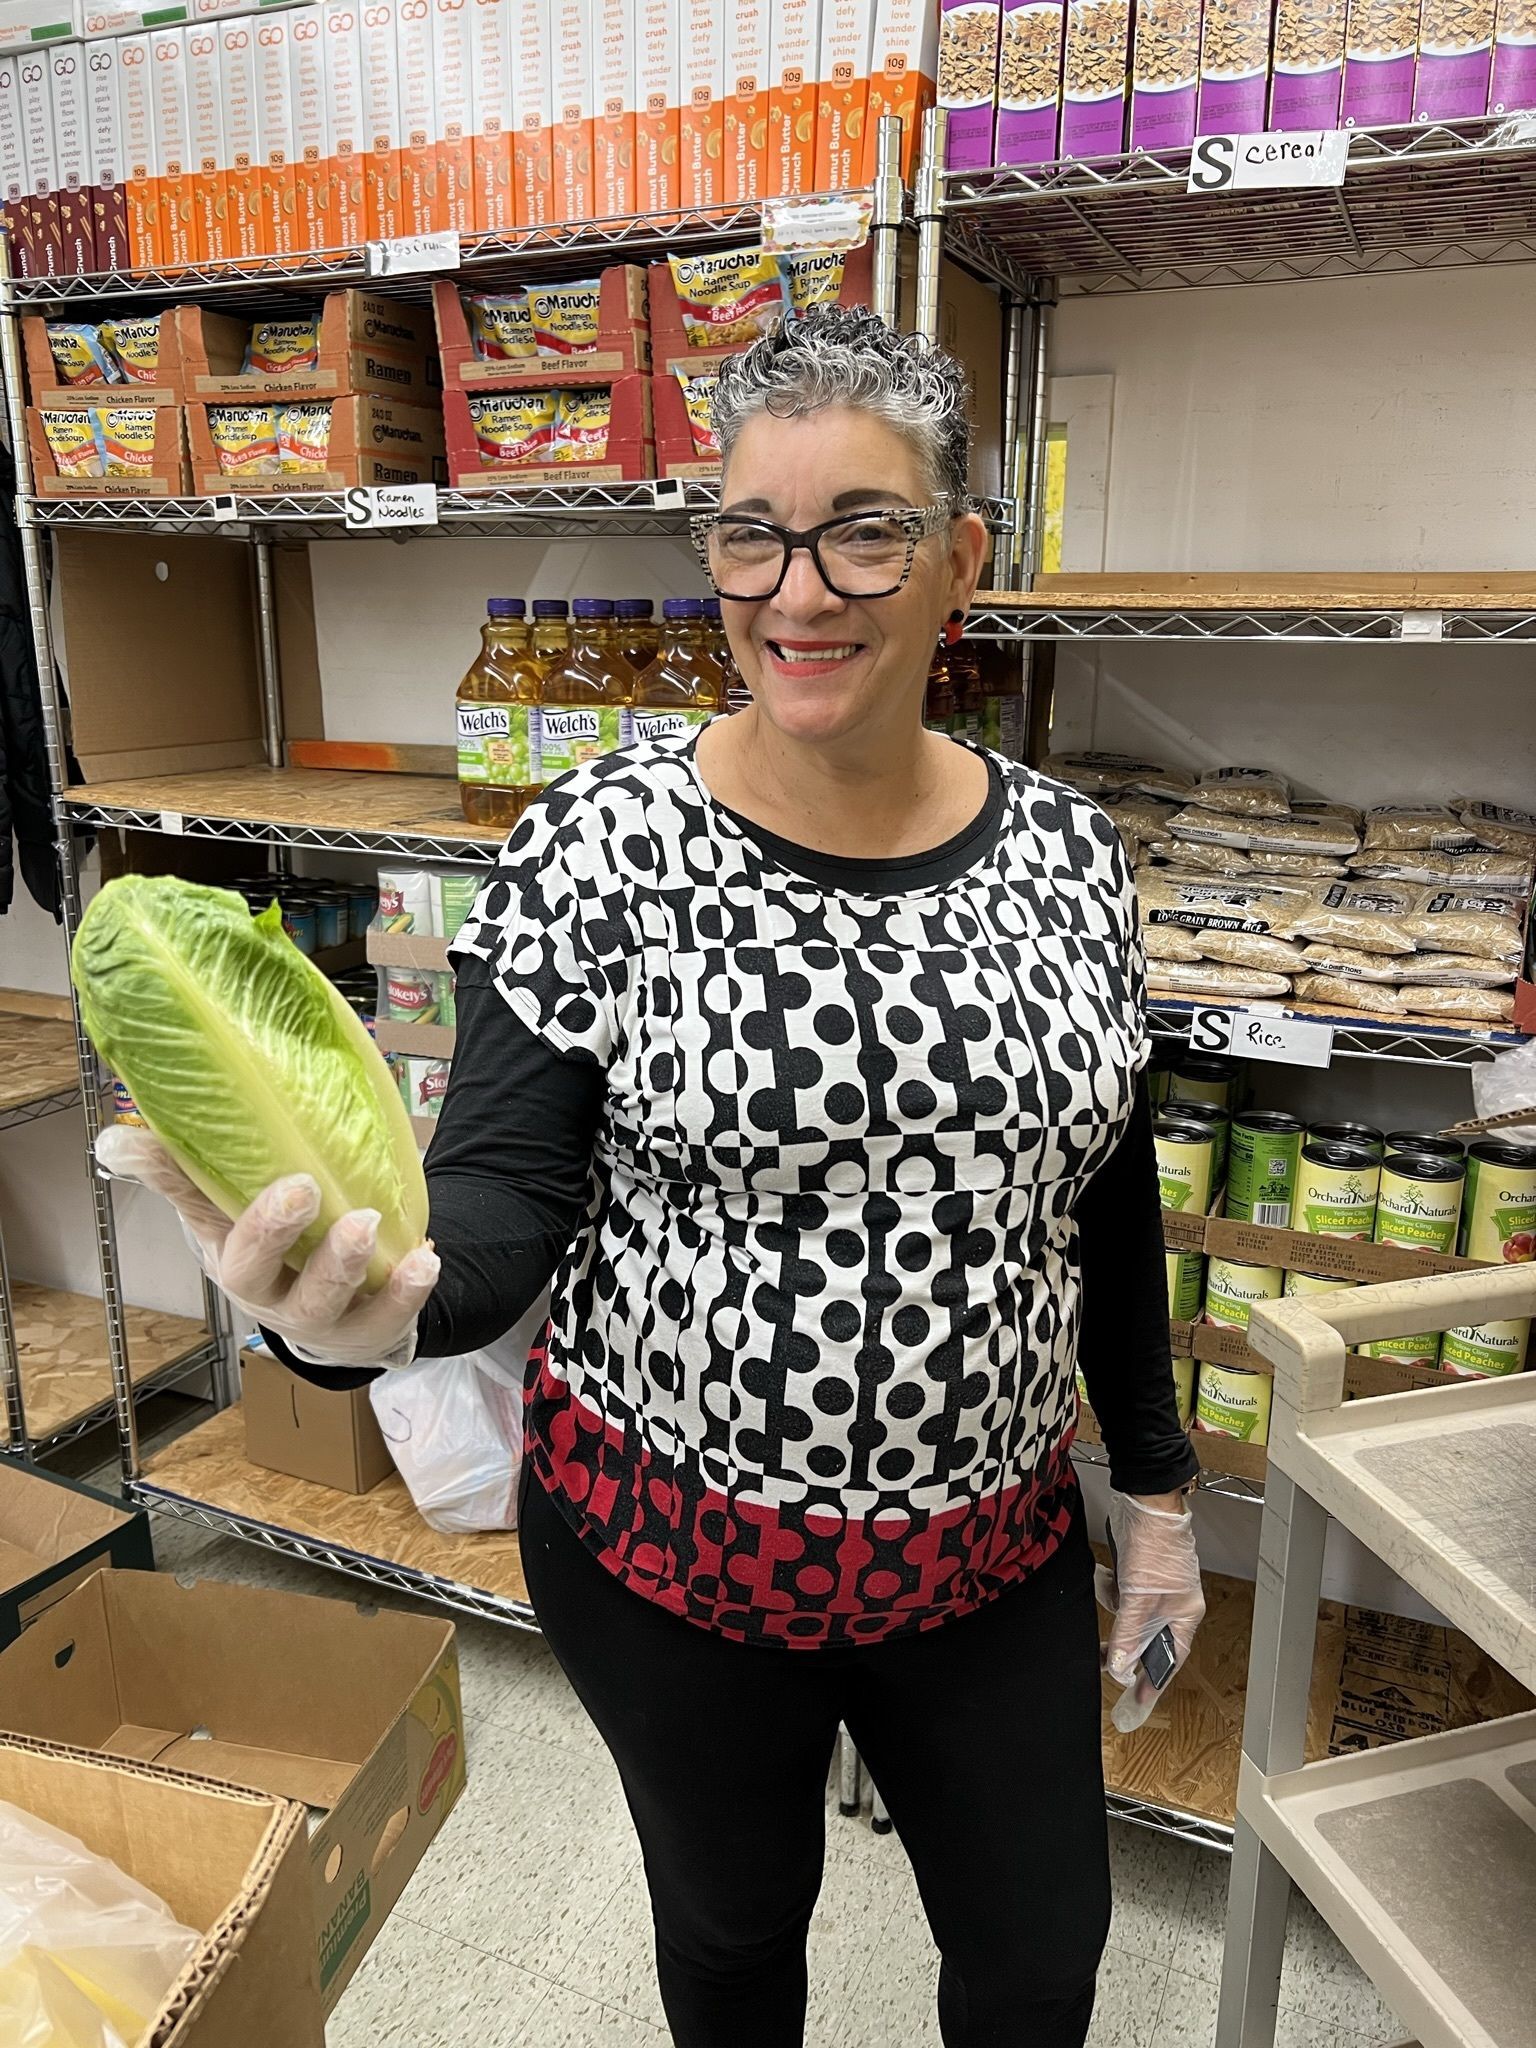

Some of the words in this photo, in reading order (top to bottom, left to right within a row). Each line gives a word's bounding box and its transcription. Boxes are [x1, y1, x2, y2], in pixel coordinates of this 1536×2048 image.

[400, 1, 427, 21] GO
[645, 1, 667, 14] spark
[692, 5, 710, 17] flow
[836, 6, 856, 18] defy
[364, 6, 391, 28] GO
[647, 13, 666, 25] flow
[735, 8, 759, 20] crush
[784, 12, 804, 24] defy
[890, 9, 910, 21] love
[328, 13, 354, 35] GO
[690, 18, 713, 31] crush
[736, 21, 757, 33] defy
[836, 18, 855, 29] love
[882, 22, 917, 34] wander
[258, 26, 284, 46] GO
[293, 20, 319, 42] GO
[645, 26, 668, 39] crush
[784, 25, 804, 36] love
[224, 31, 249, 50] GO
[692, 32, 711, 44] defy
[737, 34, 756, 45] love
[777, 38, 811, 50] wander
[828, 33, 862, 44] wander
[885, 37, 911, 48] shine
[155, 41, 179, 62] GO
[190, 36, 214, 57] GO
[647, 40, 666, 52] defy
[692, 45, 710, 56] love
[832, 46, 856, 57] shine
[122, 47, 145, 66] GO
[730, 46, 764, 59] wander
[781, 50, 805, 62] shine
[89, 53, 112, 72] GO
[647, 53, 666, 65] love
[686, 57, 717, 69] wander
[735, 59, 758, 71] shine
[887, 57, 905, 71] 10g
[54, 57, 76, 76] GO
[641, 64, 672, 76] wander
[834, 66, 852, 79] 10g
[22, 64, 43, 84] GO
[690, 69, 713, 81] shine
[783, 70, 801, 83] 10g
[645, 78, 668, 89] shine
[737, 79, 755, 92] 10g
[693, 89, 709, 102] 10g
[648, 96, 664, 109] 10g
[63, 129, 76, 138] defy
[97, 126, 111, 135] defy
[781, 113, 791, 153] Butter
[829, 109, 841, 149] Butter
[736, 122, 746, 160] Butter
[1192, 137, 1234, 189] S
[1245, 131, 1325, 165] cereal
[68, 175, 77, 184] 9g
[102, 172, 112, 182] 9g
[703, 272, 739, 286] Ramen
[689, 284, 727, 298] Noodle
[560, 312, 592, 321] Ramen
[550, 322, 581, 331] Noodle
[263, 346, 286, 355] Noodle
[286, 346, 304, 354] Soup
[365, 357, 412, 381] Ramen
[541, 360, 560, 370] Beef
[561, 359, 588, 370] Flavor
[264, 383, 293, 392] Chicken
[293, 381, 317, 391] Flavor
[106, 395, 133, 405] Chicken
[134, 395, 156, 404] Flavor
[479, 396, 545, 414] Maruchan
[491, 414, 522, 423] Ramen
[480, 422, 512, 433] Noodle
[513, 422, 533, 432] Soup
[114, 432, 144, 440] Noodle
[124, 451, 154, 462] Chicke
[372, 462, 418, 485] Ramen
[543, 471, 563, 481] Beef
[564, 470, 590, 481] Flavor
[104, 486, 131, 495] Chicken
[131, 486, 151, 494] Flavor
[272, 482, 300, 492] Chicken
[300, 482, 325, 491] Flavor
[346, 487, 372, 524] S
[376, 489, 415, 504] Ramen
[378, 506, 425, 518] Noodles
[460, 710, 507, 731] Welch's
[544, 714, 597, 735] Welch's
[1179, 914, 1206, 925] GRAIN
[1206, 918, 1239, 930] BROWN
[1328, 964, 1362, 975] DIRECTIONS
[1193, 1010, 1231, 1050] S
[1159, 1165, 1191, 1177] aturals
[1308, 1186, 1351, 1205] Orchard
[1499, 1190, 1536, 1203] Orchar
[1333, 1210, 1354, 1218] Yellow
[1417, 1205, 1457, 1217] Naturals
[1315, 1214, 1345, 1226] Sliced
[1394, 1218, 1415, 1227] Yellow
[1415, 1221, 1432, 1231] Cling
[1381, 1219, 1406, 1235] Sliced
[1406, 1225, 1447, 1240] Peaches
[1227, 1285, 1269, 1299] Naturals
[1226, 1301, 1241, 1310] Cling
[1475, 1332, 1519, 1346] Naturals
[1453, 1342, 1471, 1352] Yellow
[1471, 1348, 1489, 1358] Cling
[1464, 1352, 1505, 1370] Peaches
[1217, 1392, 1258, 1407] Naturals
[1210, 1407, 1245, 1427] Peaches
[1341, 1700, 1377, 1716] BLUE
